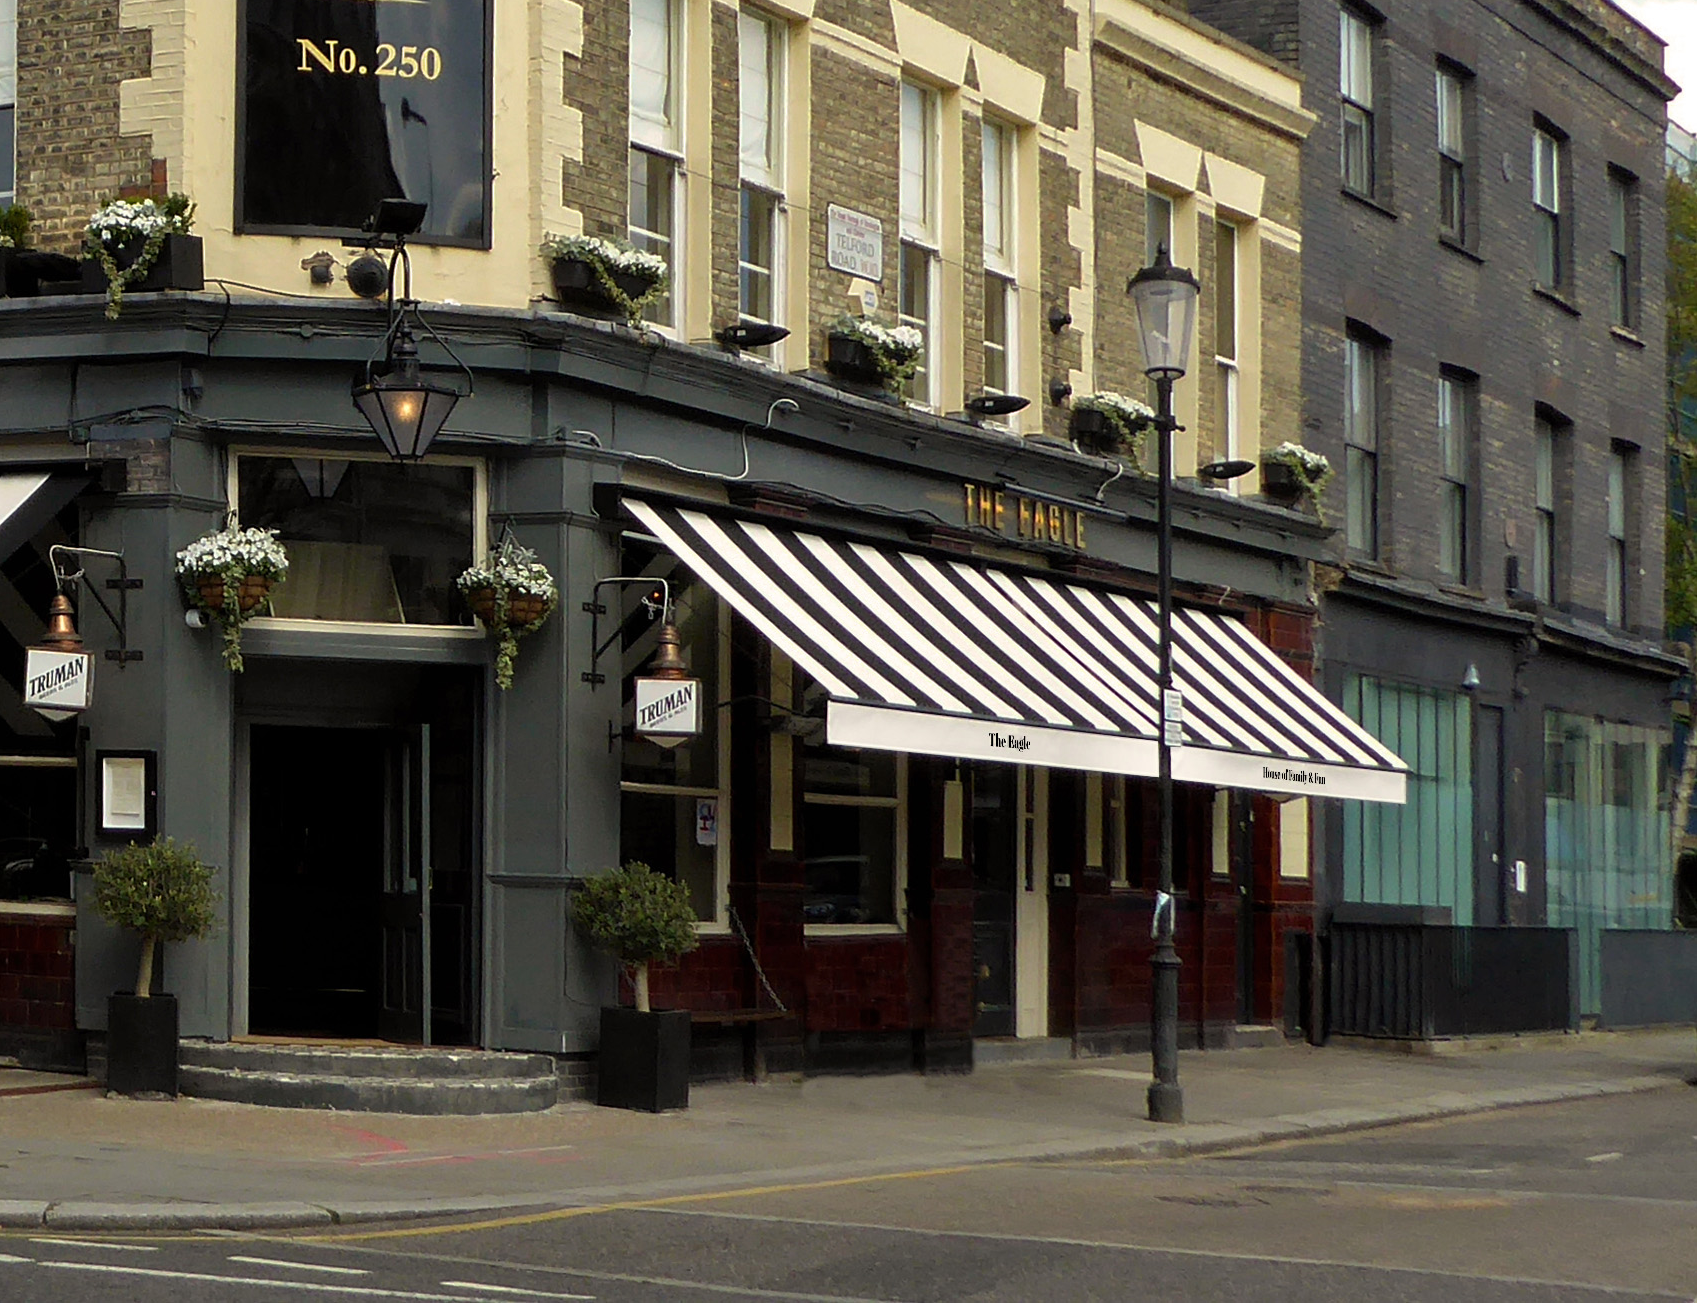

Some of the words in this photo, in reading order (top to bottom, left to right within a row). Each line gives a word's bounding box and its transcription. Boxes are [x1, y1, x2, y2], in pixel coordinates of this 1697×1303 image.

[296, 39, 368, 75] No.
[374, 44, 442, 80] 250
[836, 232, 875, 258] TELFORD
[964, 483, 1005, 531] THE
[1018, 497, 1087, 550] EAGLE
[29, 655, 85, 697] TRUMAN
[639, 683, 694, 726] TRUMAN
[988, 732, 1007, 748] The
[1008, 734, 1031, 753] Eagle
[1262, 766, 1281, 780] House
[1281, 768, 1289, 781] of
[1288, 769, 1308, 785] Family
[1308, 771, 1314, 784] &
